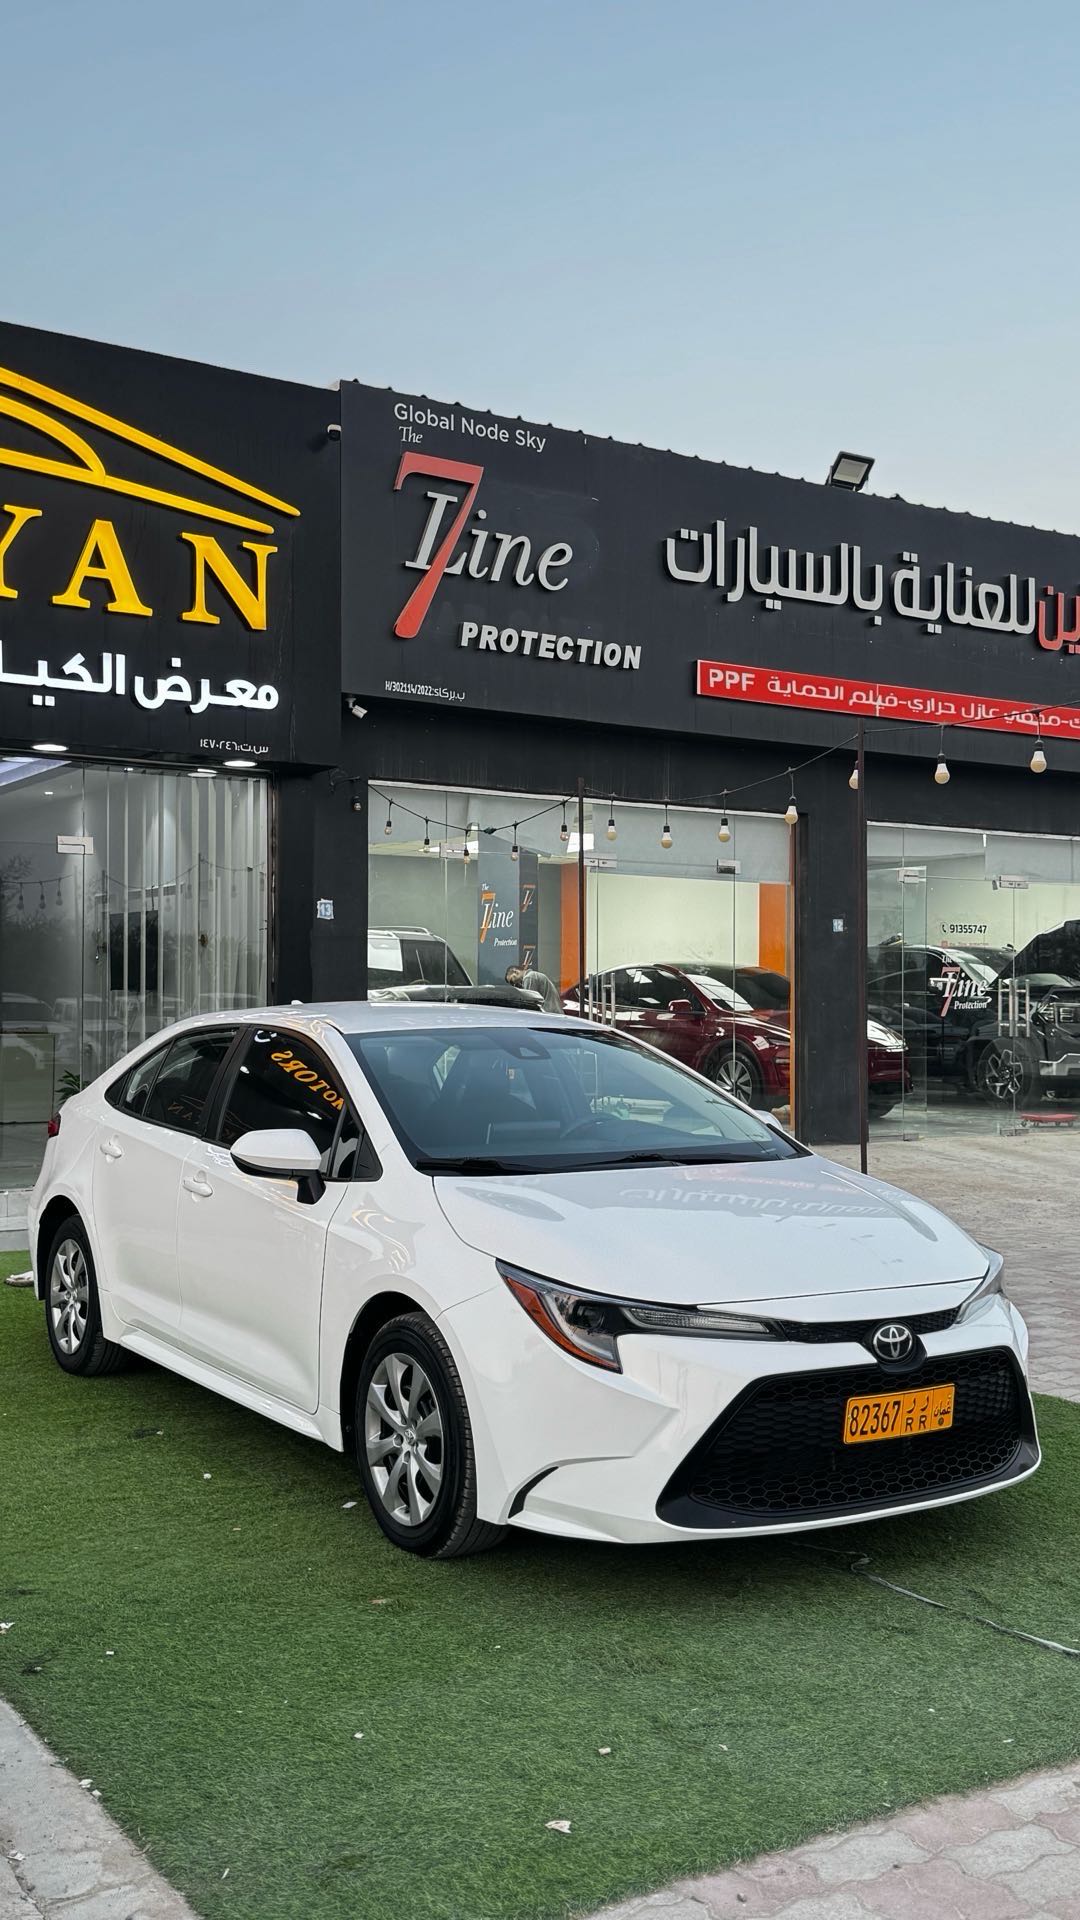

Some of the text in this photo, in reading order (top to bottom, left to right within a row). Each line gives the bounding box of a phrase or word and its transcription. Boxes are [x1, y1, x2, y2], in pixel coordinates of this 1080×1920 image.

[393, 402, 546, 452] Global Node Sky
[398, 425, 423, 443] The
[666, 519, 884, 627] بالسيارات
[893, 551, 1036, 635] للعناية
[460, 621, 642, 670] PROTECTION
[0, 639, 279, 714] معرض الكي
[708, 668, 756, 692] PPF
[767, 675, 844, 702] الحماية
[961, 703, 1000, 720] عازل
[949, 924, 988, 934] 91355747
[953, 1000, 988, 1010] Protection
[849, 1400, 902, 1437] 82367
